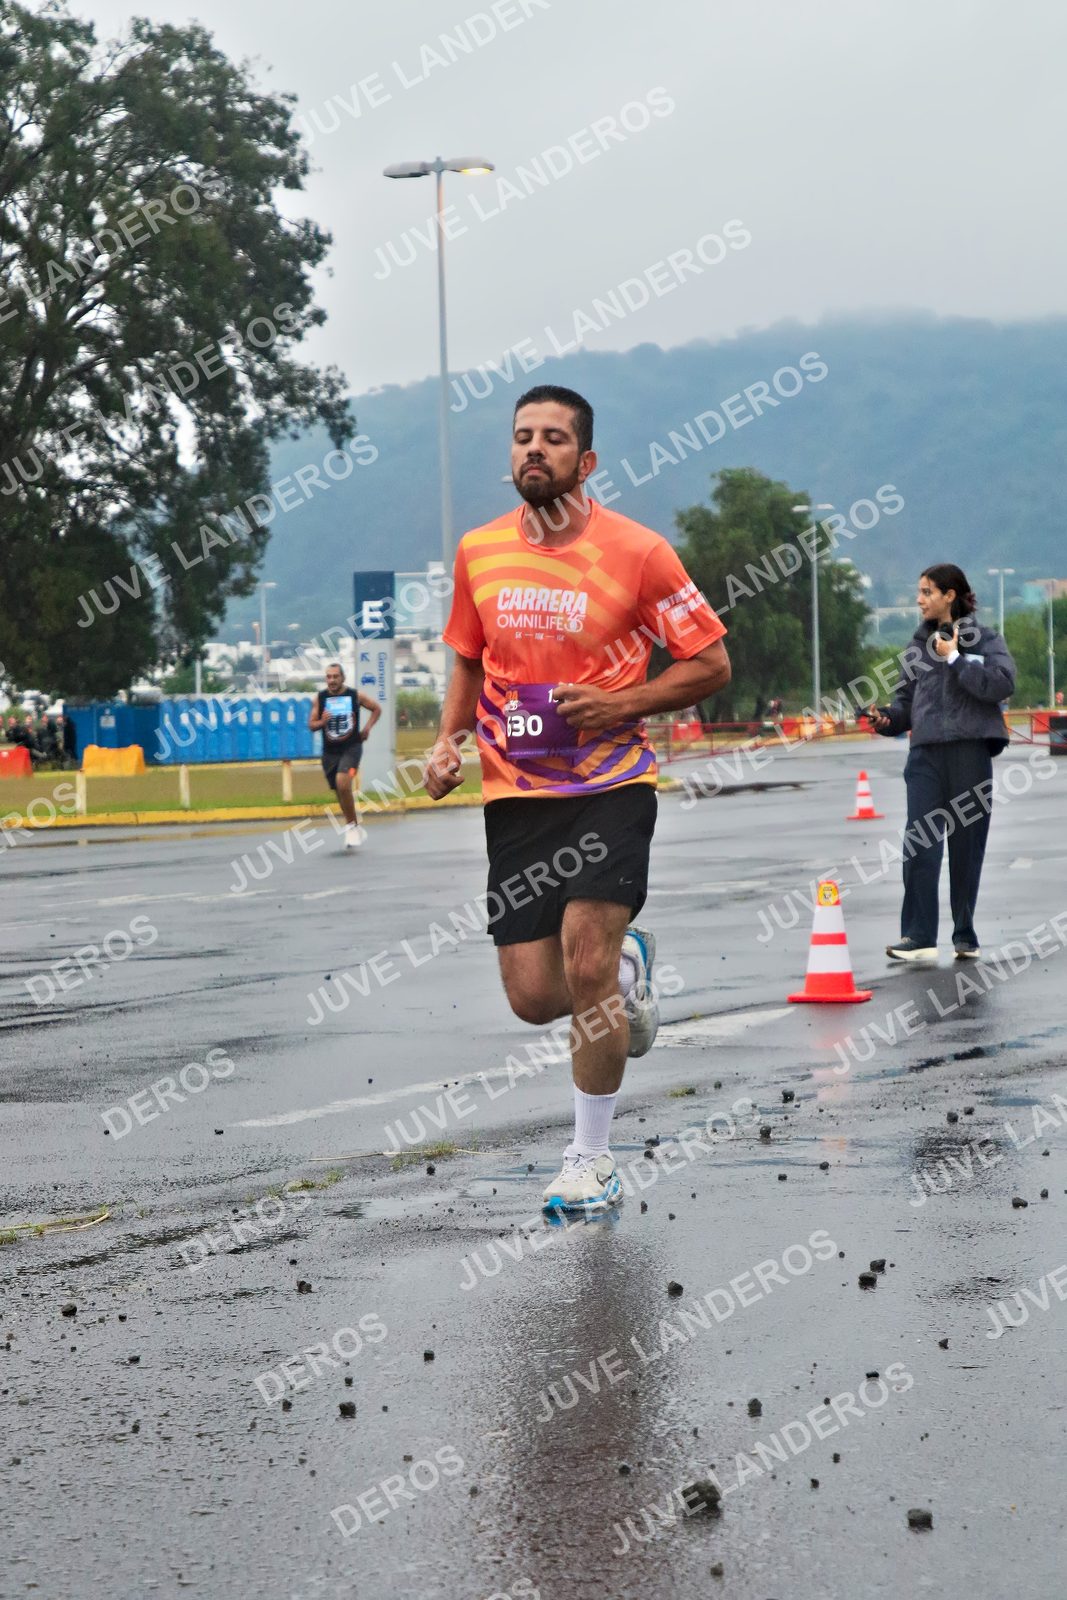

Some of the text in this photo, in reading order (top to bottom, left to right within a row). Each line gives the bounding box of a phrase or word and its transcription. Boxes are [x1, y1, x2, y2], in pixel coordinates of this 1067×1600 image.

[497, 587, 588, 614] CARRERA
[362, 600, 384, 629] E
[497, 613, 564, 630] OMNILIFE
